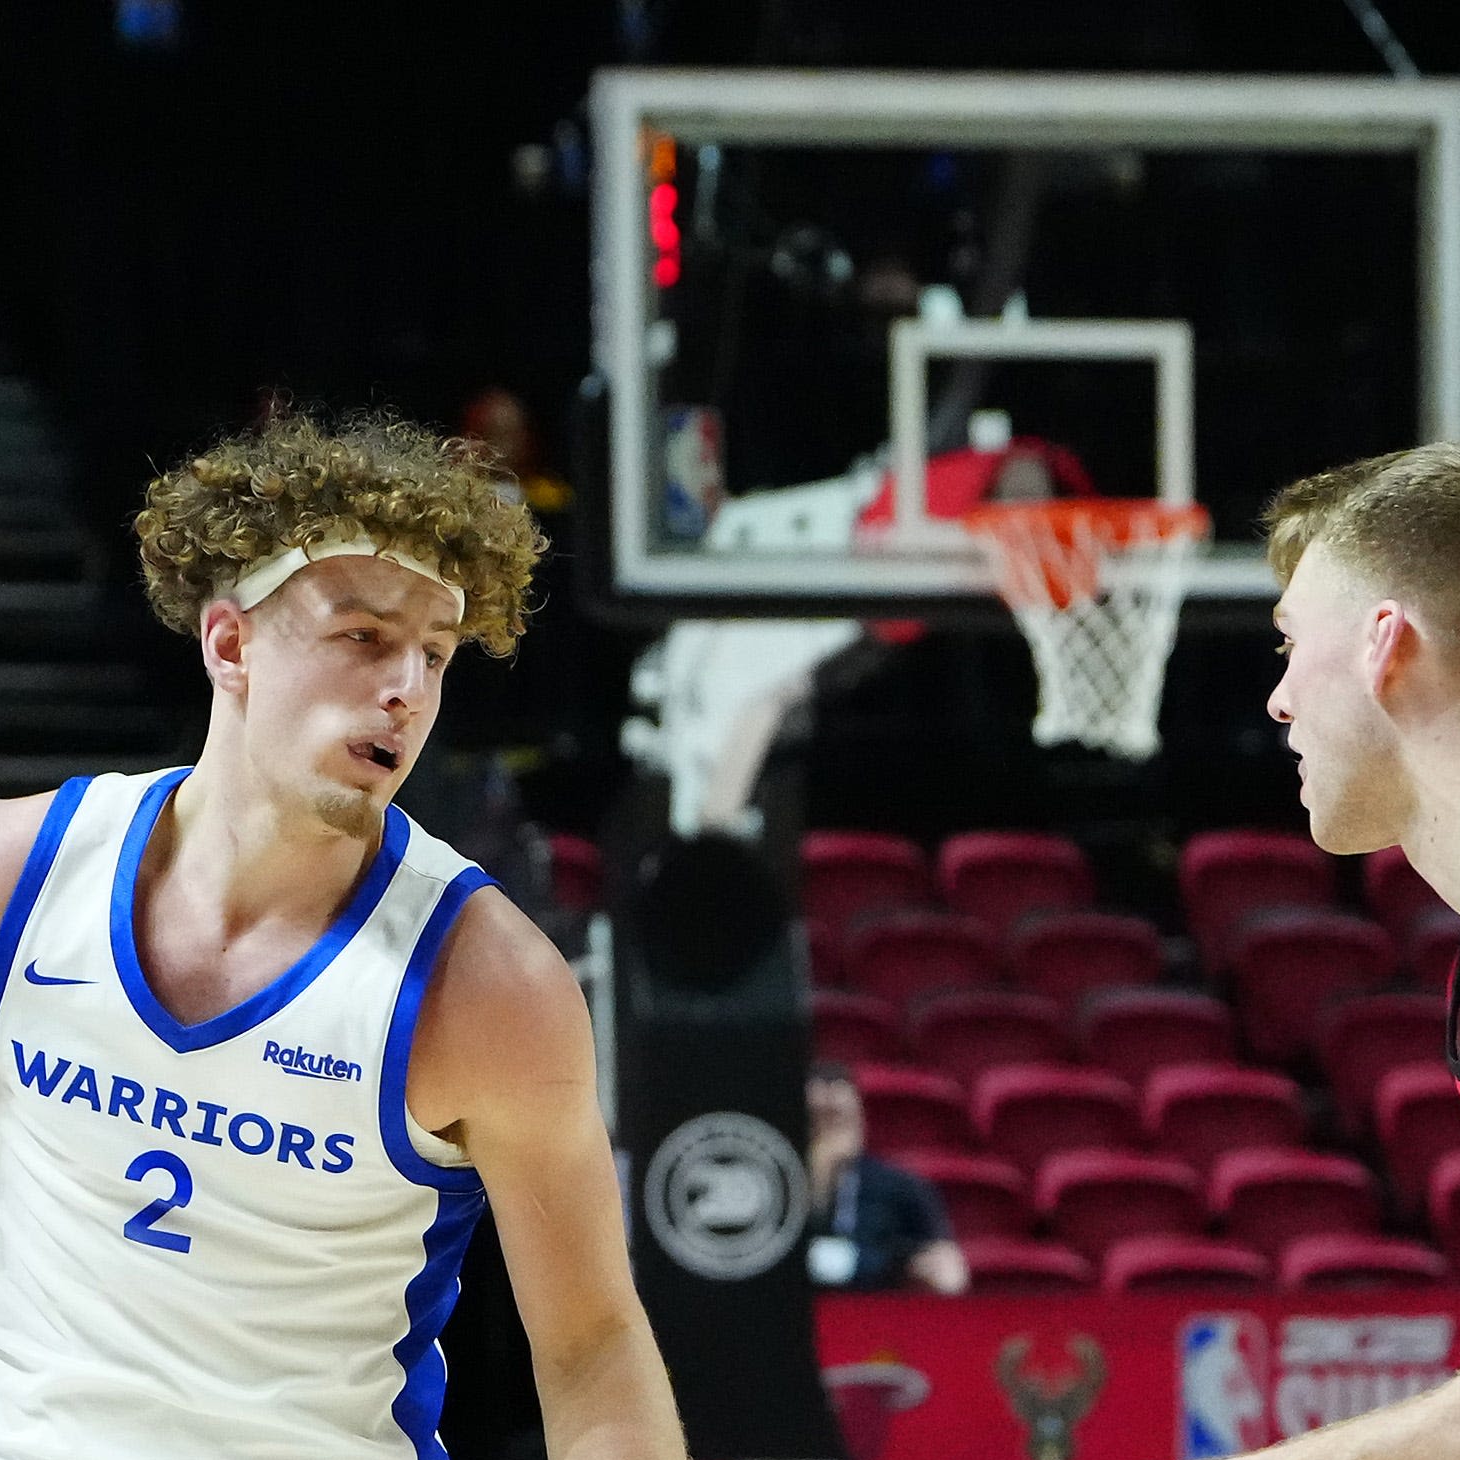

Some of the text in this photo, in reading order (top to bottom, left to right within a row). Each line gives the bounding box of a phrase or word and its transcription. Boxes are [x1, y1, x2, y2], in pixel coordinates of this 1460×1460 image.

[11, 1039, 355, 1174] WARRIORS
[262, 1040, 362, 1083] Rakuten
[123, 1150, 193, 1255] 2
